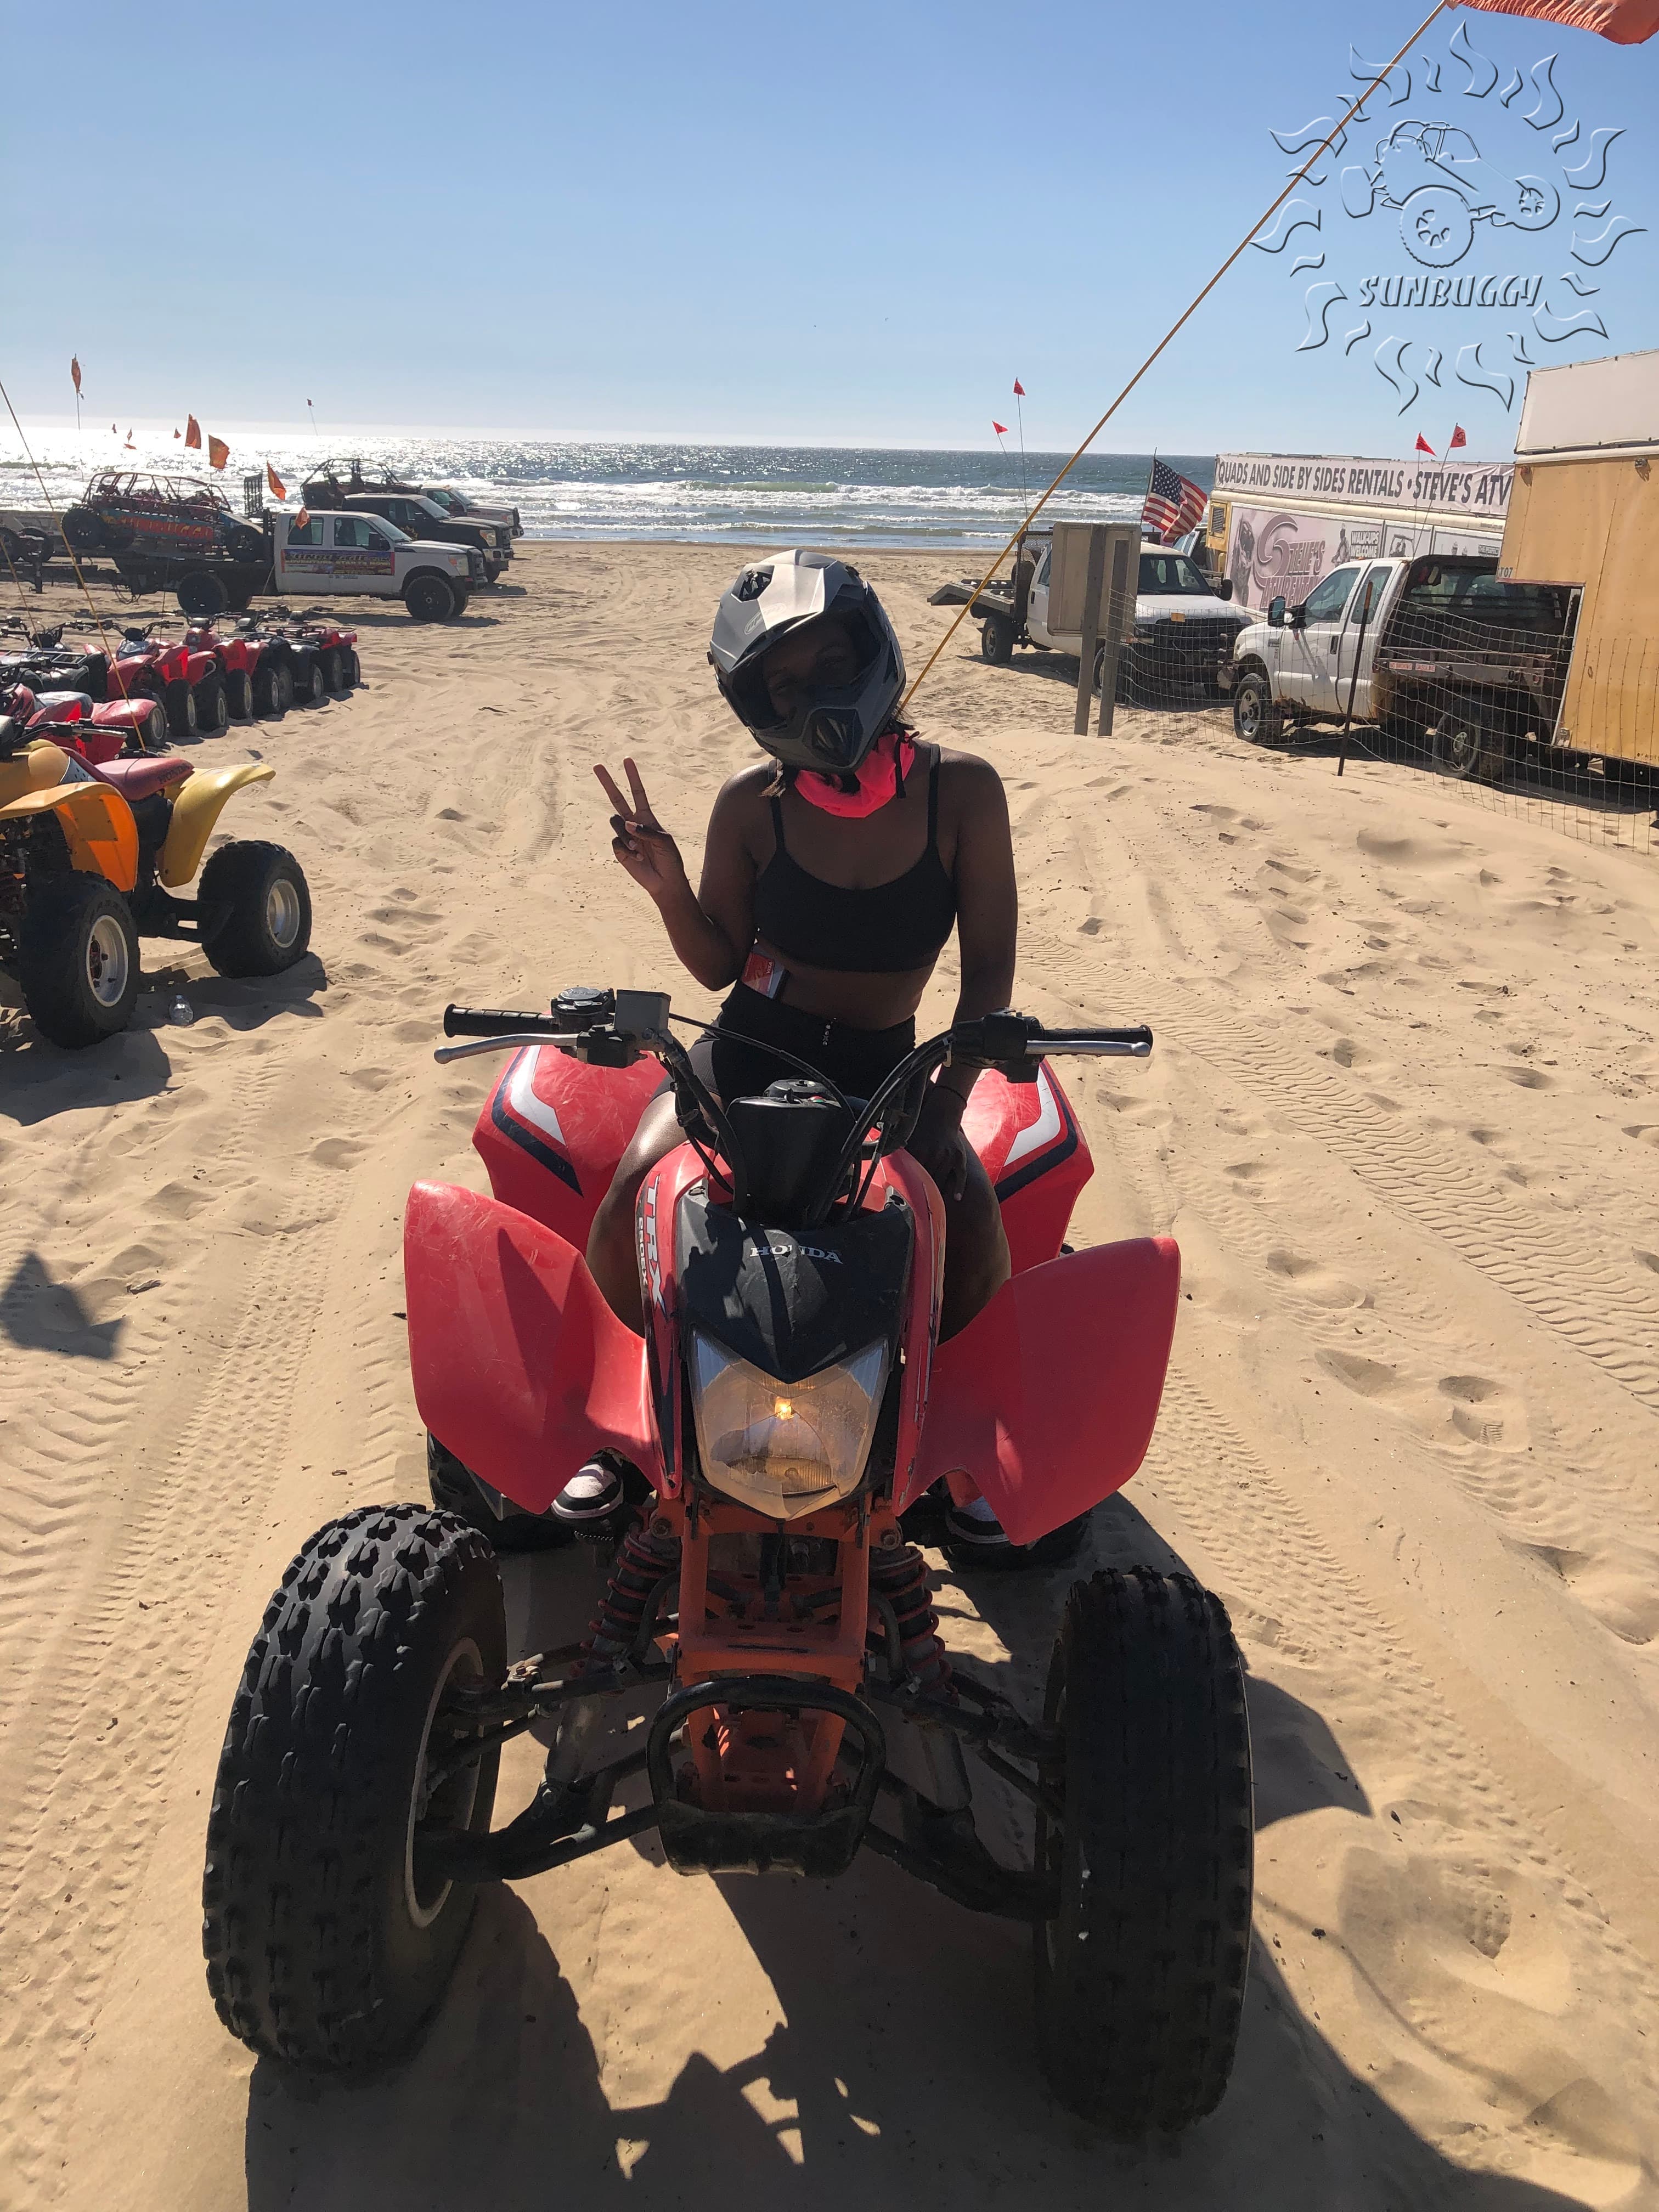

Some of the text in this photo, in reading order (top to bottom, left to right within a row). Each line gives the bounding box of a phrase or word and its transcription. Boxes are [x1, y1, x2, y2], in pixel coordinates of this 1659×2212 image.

[1218, 461, 1514, 506] QUADS AND SIDE BY SIDES RENTALS STEVE'S ATV
[1351, 545, 1378, 558] WELCOME
[639, 1216, 648, 1286] 250EX
[646, 1174, 668, 1319] TRX
[749, 1244, 843, 1264] HONDA
